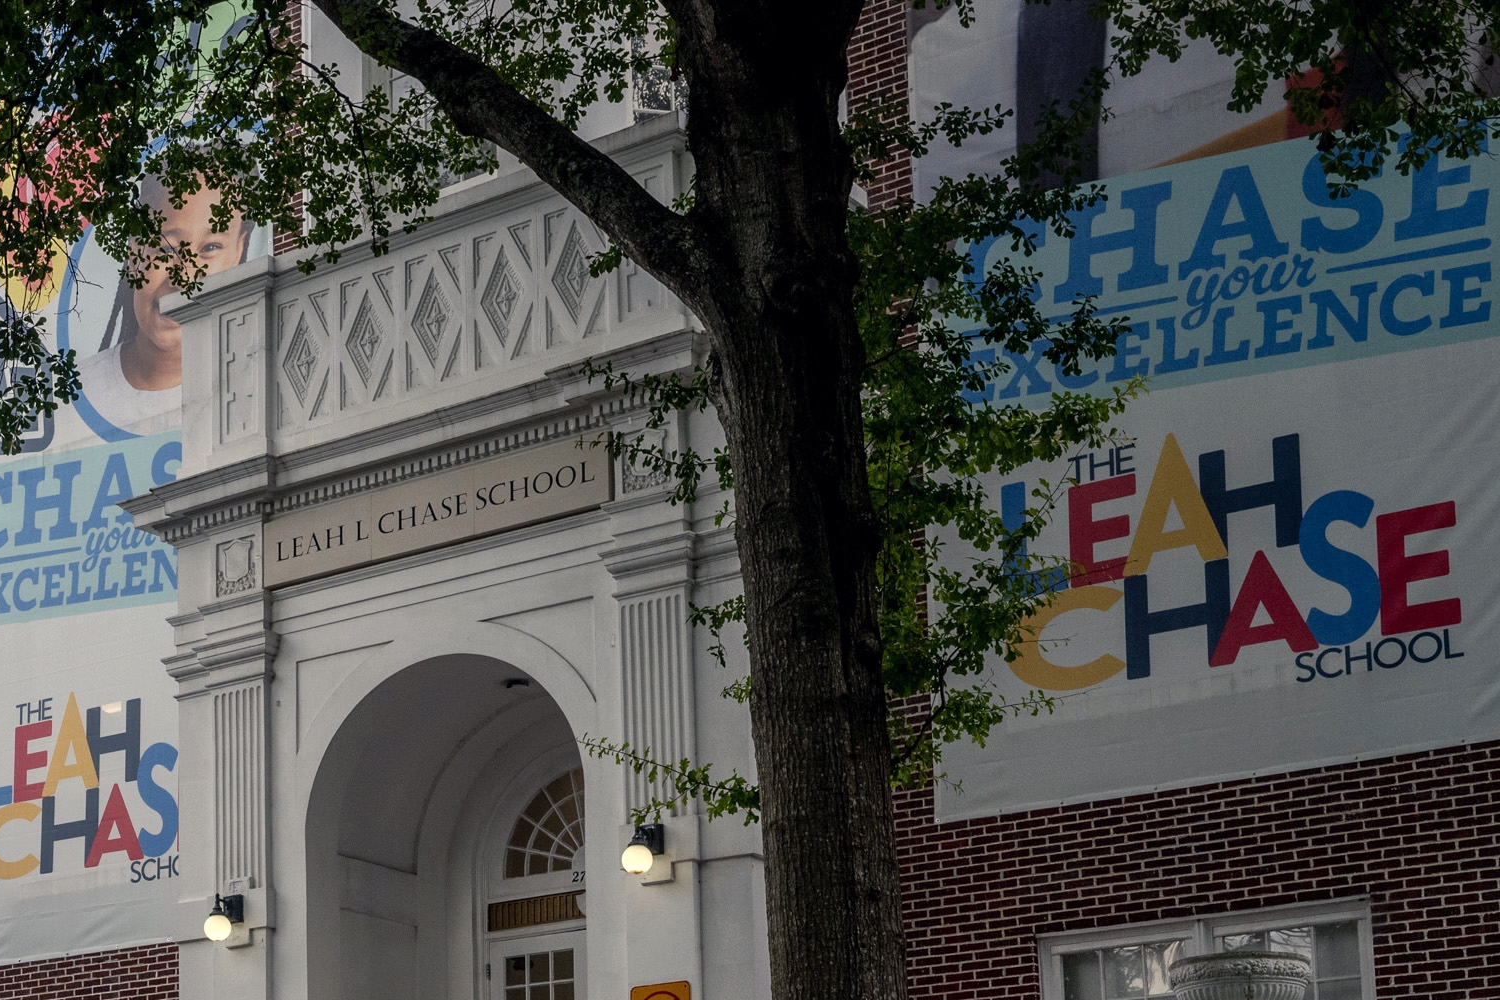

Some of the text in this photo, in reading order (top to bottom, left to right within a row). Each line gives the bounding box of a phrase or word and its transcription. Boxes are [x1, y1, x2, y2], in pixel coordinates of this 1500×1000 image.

[962, 117, 1490, 308] CHASE
[1181, 253, 1317, 330] your
[1067, 444, 1136, 483] THE
[276, 461, 596, 563] LEAH L CHASE SCHOOL
[1001, 433, 1302, 594] LEAH
[1006, 489, 1462, 691] CHASE
[1295, 628, 1464, 684] SCHOOL
[16, 697, 53, 726] THE
